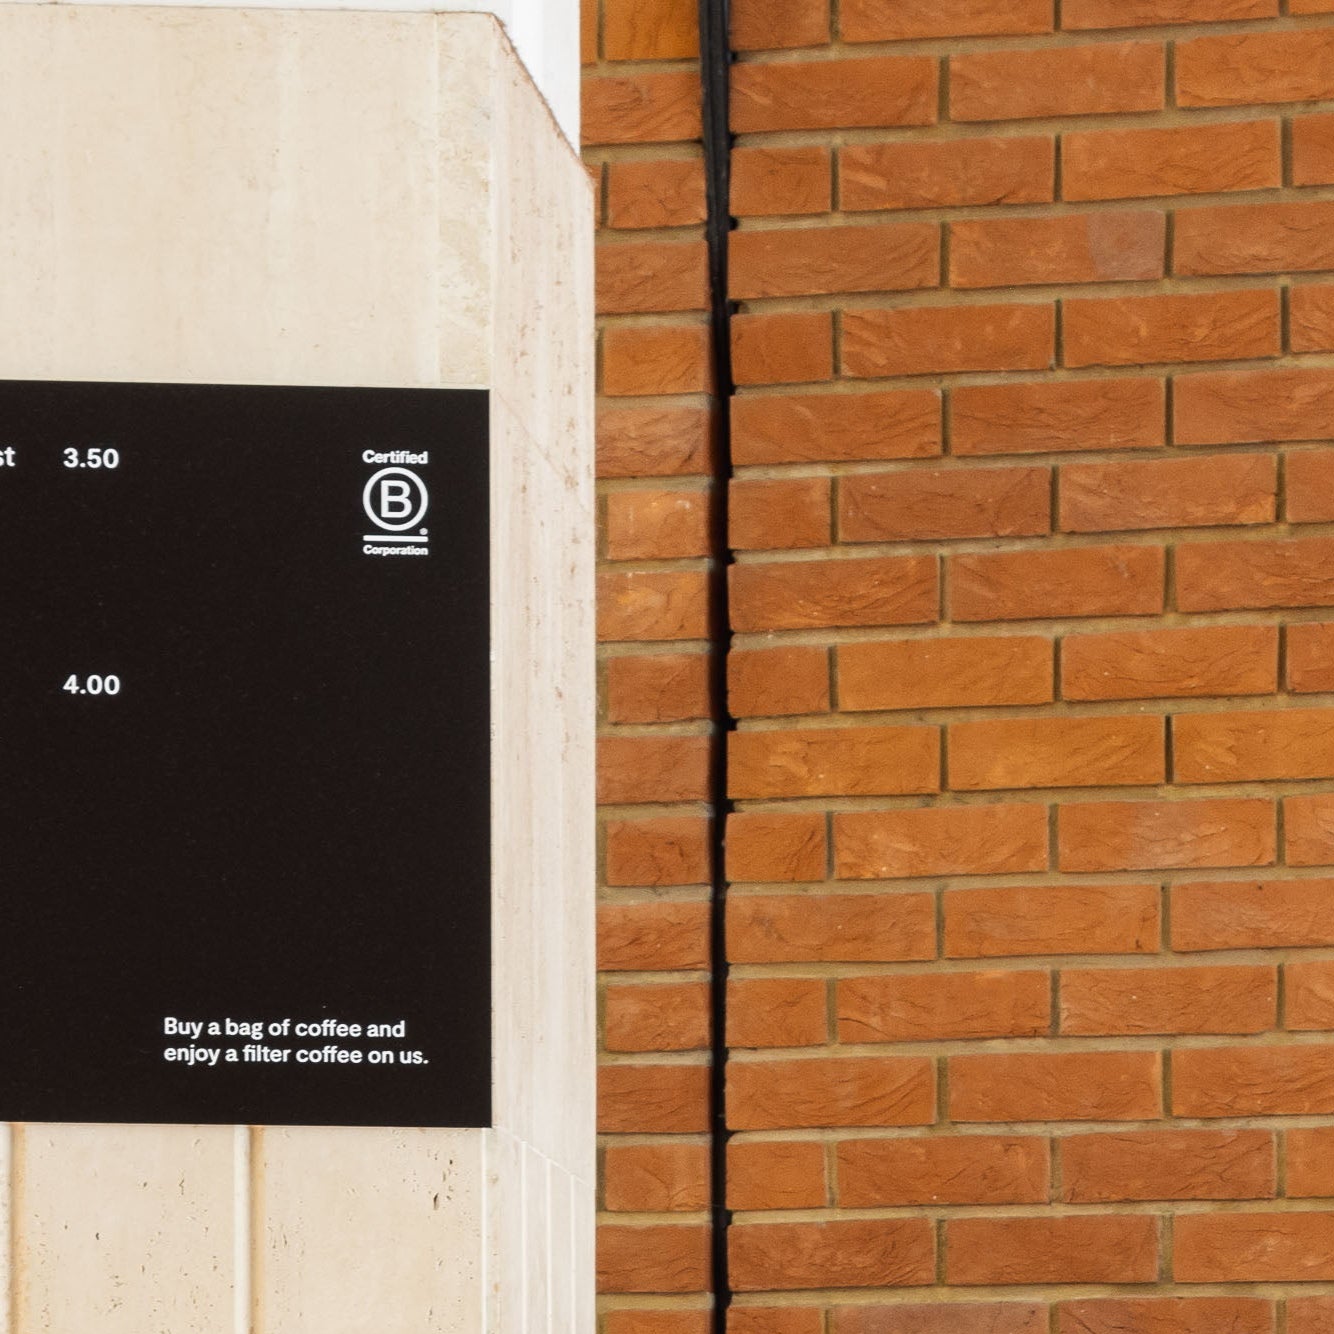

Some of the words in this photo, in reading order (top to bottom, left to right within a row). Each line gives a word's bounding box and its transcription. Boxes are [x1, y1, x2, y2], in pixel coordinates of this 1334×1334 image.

[63, 447, 120, 469] 3.50
[362, 449, 429, 465] Certified
[380, 479, 413, 519] B
[362, 544, 429, 557] Corporation
[62, 674, 121, 696] 4.00
[163, 1016, 204, 1040] Buy
[207, 1021, 222, 1036] a
[225, 1017, 264, 1041] bag
[267, 1018, 291, 1037] of
[294, 1018, 362, 1038] coffee
[366, 1019, 406, 1038] and
[163, 1044, 220, 1067] enjoy
[224, 1048, 240, 1062] a
[241, 1044, 292, 1063] filter
[295, 1045, 363, 1064] coffee
[367, 1050, 395, 1064] on
[399, 1050, 430, 1065] us.
